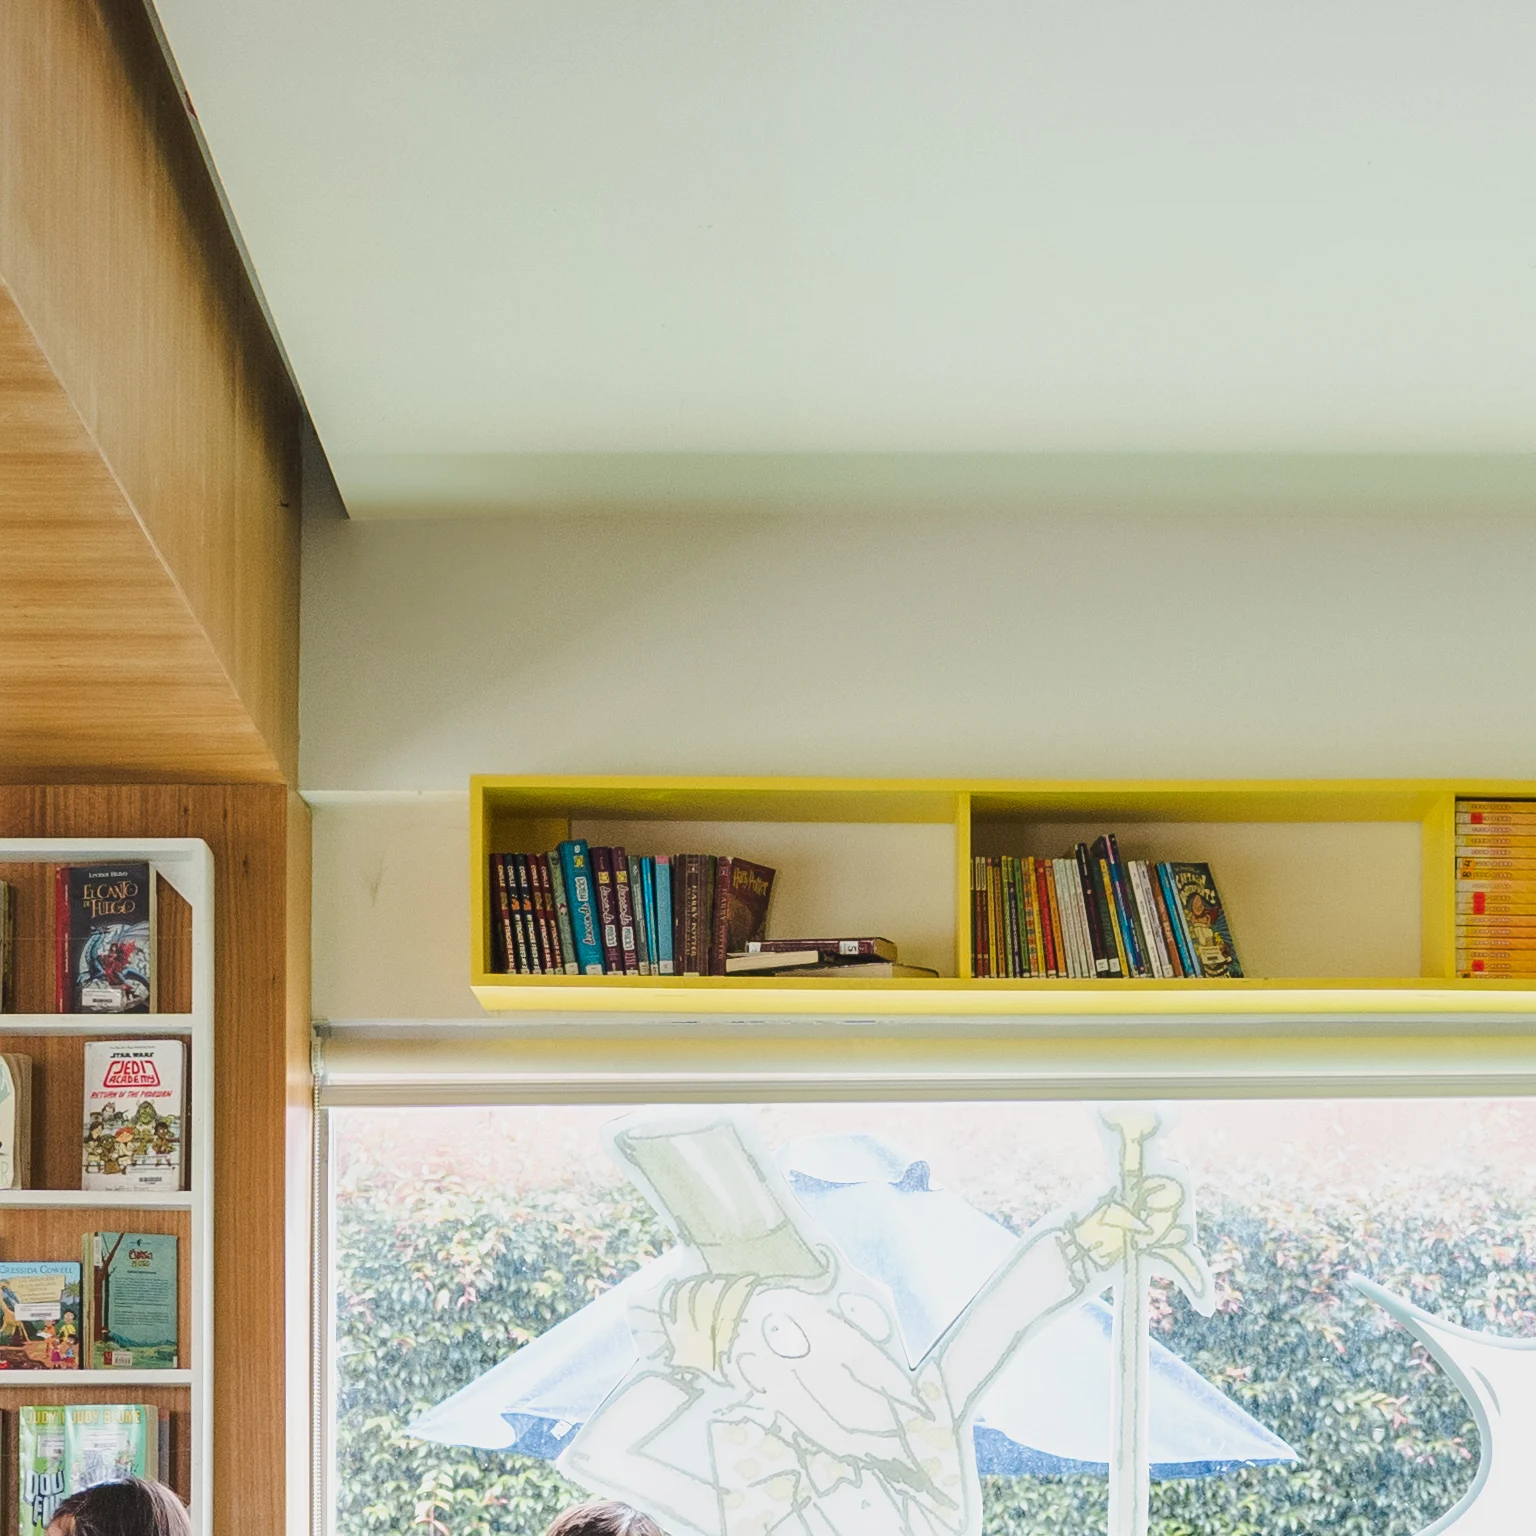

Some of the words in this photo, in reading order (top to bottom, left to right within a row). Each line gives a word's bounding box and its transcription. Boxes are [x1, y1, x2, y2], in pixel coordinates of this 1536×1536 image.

[114, 1061, 147, 1075] JEDI
[109, 1075, 156, 1084] ACADEMY
[28, 1410, 57, 1425] JUDY
[72, 1410, 99, 1424] JUDY
[105, 1410, 141, 1424] BLUME
